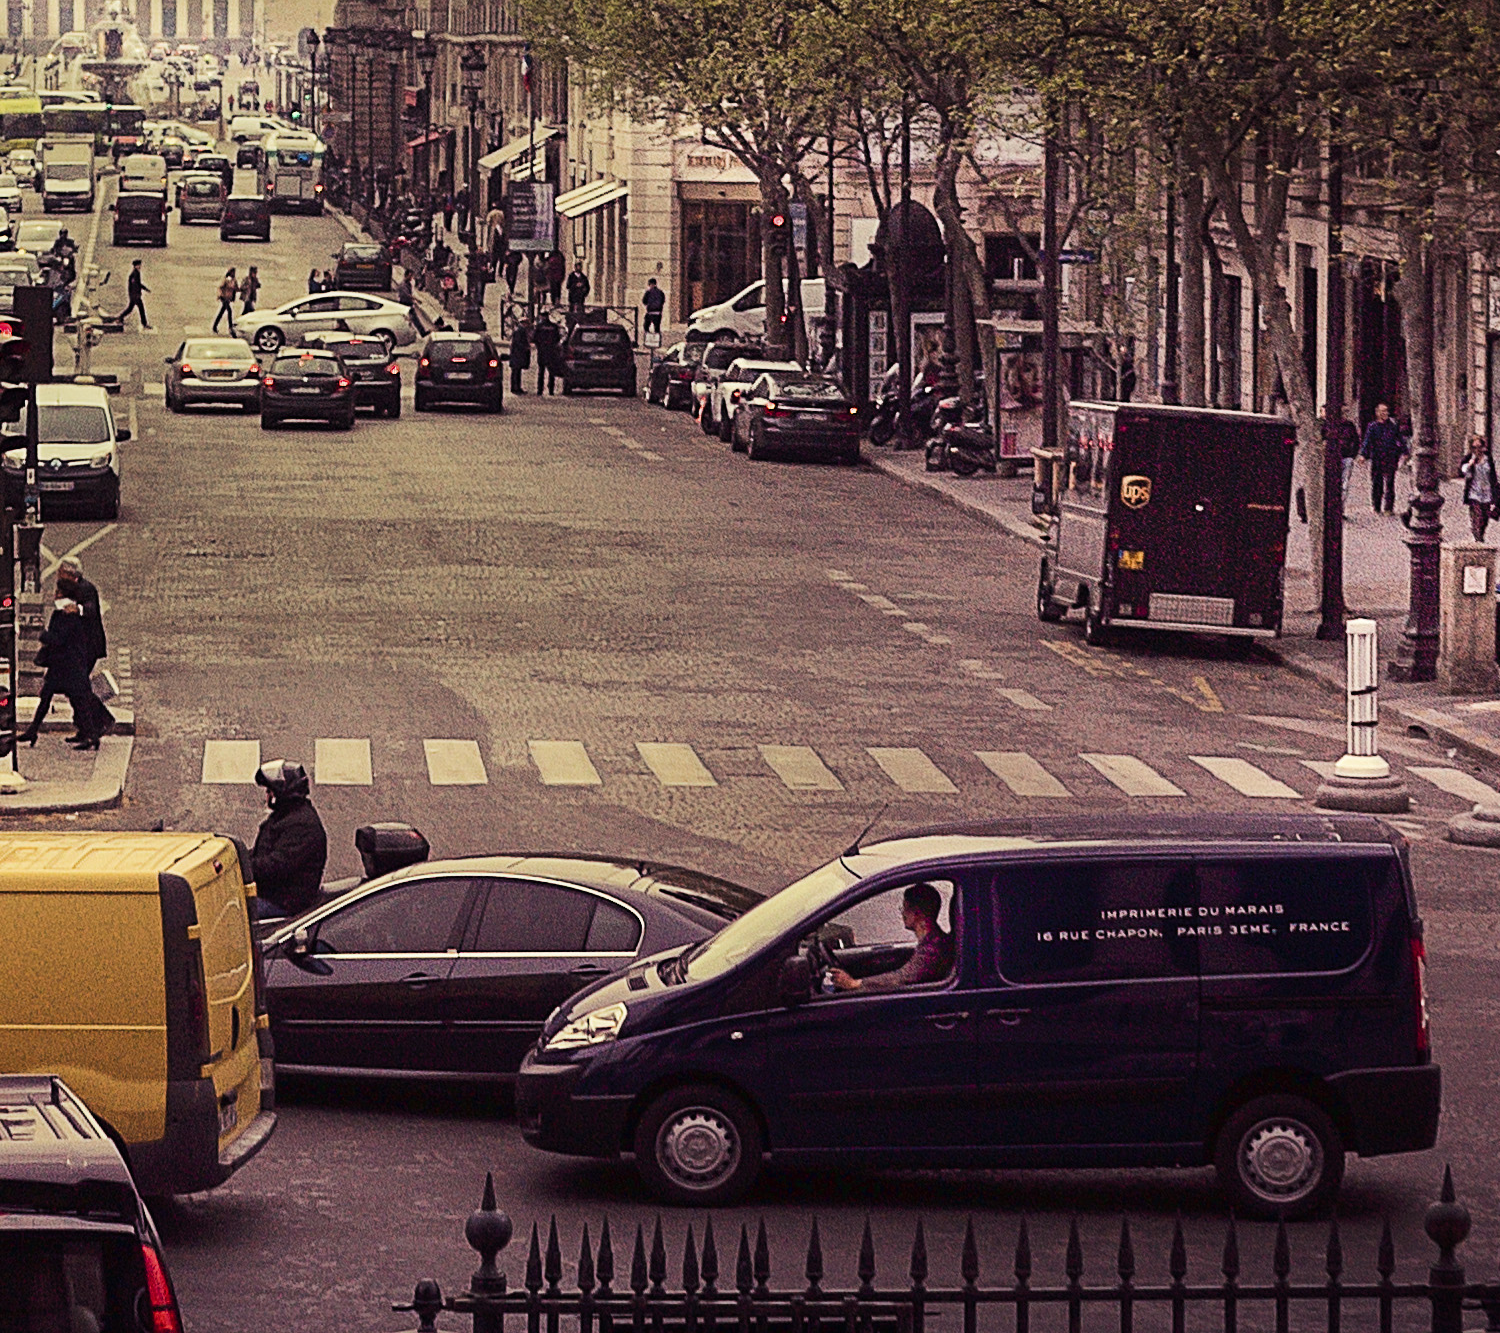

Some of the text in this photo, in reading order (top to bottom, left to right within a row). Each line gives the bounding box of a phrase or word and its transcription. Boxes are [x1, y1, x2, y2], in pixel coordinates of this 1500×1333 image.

[1101, 904, 1285, 921] IMPRIMERIE DU MARAIS
[1037, 932, 1054, 942] 16
[1059, 930, 1089, 941] RUE
[1095, 928, 1164, 940] CHAPON,
[1177, 925, 1223, 937] PARIS
[1289, 921, 1351, 933] FRANCE
